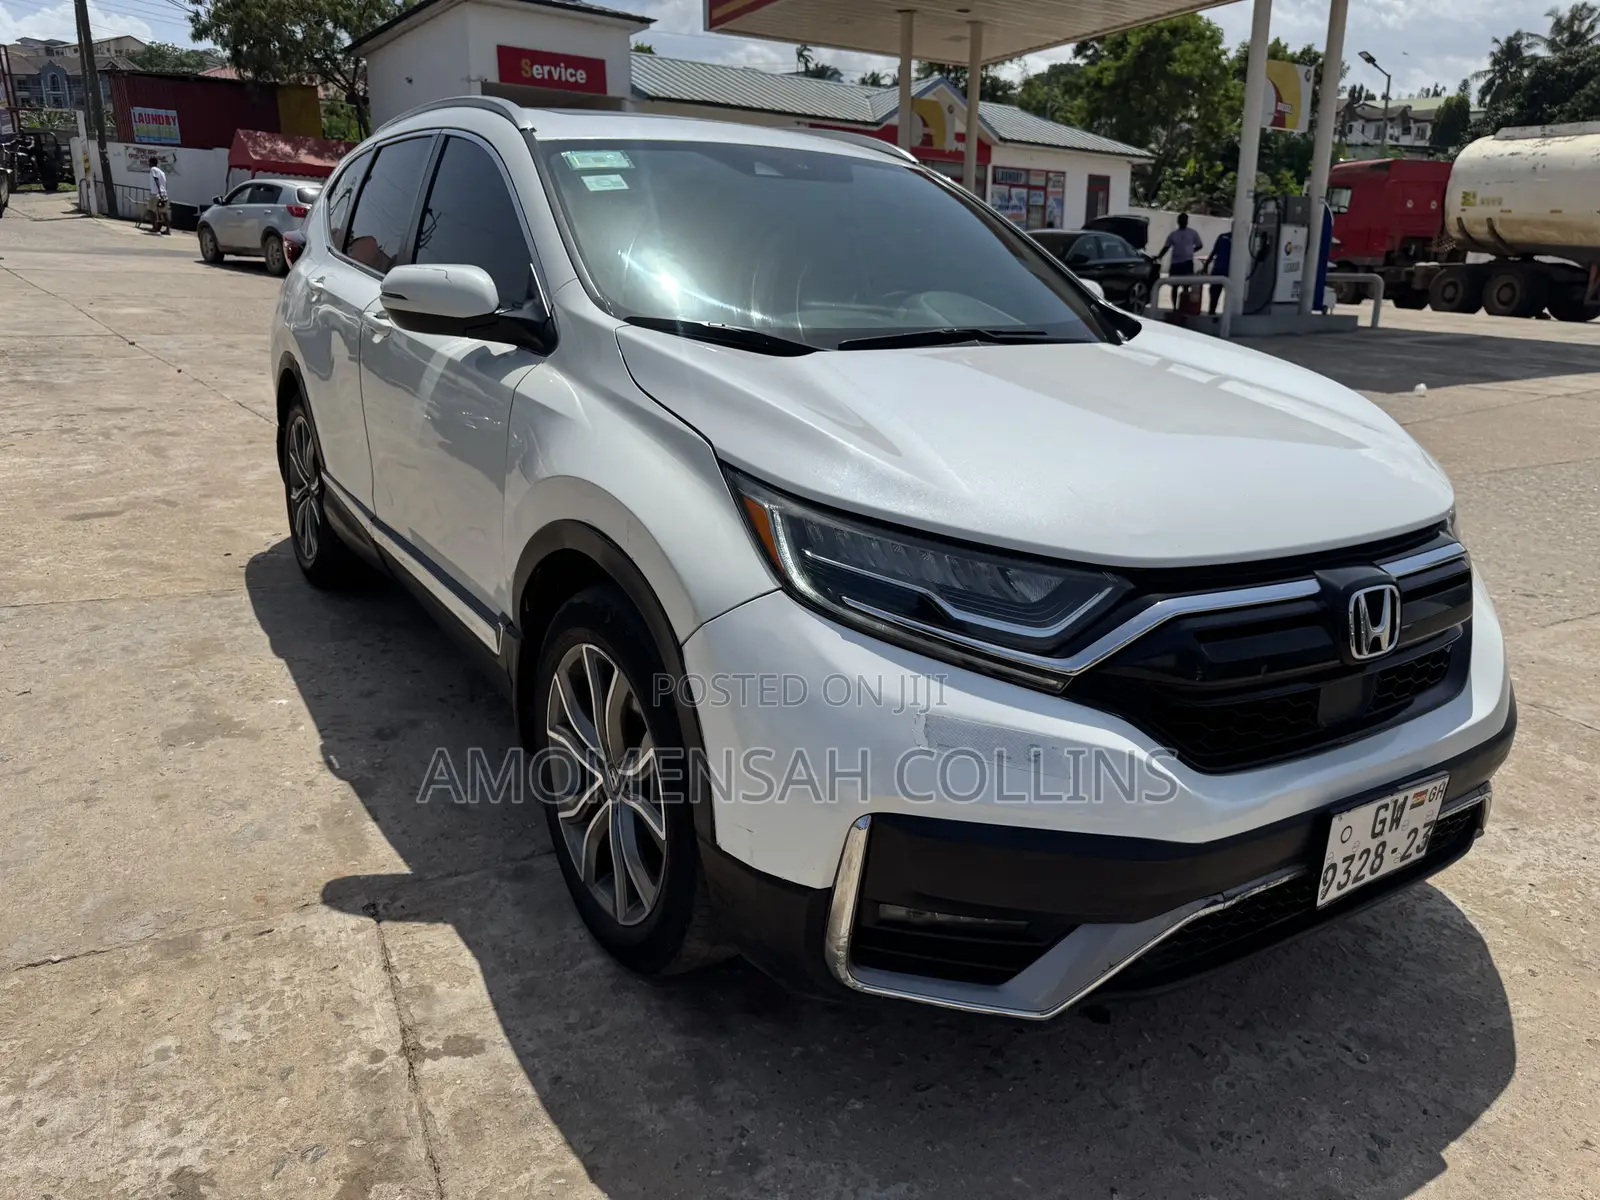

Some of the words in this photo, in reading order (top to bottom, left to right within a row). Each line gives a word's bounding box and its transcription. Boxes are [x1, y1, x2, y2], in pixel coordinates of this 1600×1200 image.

[521, 58, 587, 83] Service
[132, 111, 178, 126] LAUNDRY
[1370, 795, 1408, 839] GW
[1320, 820, 1436, 901] 9328-23
